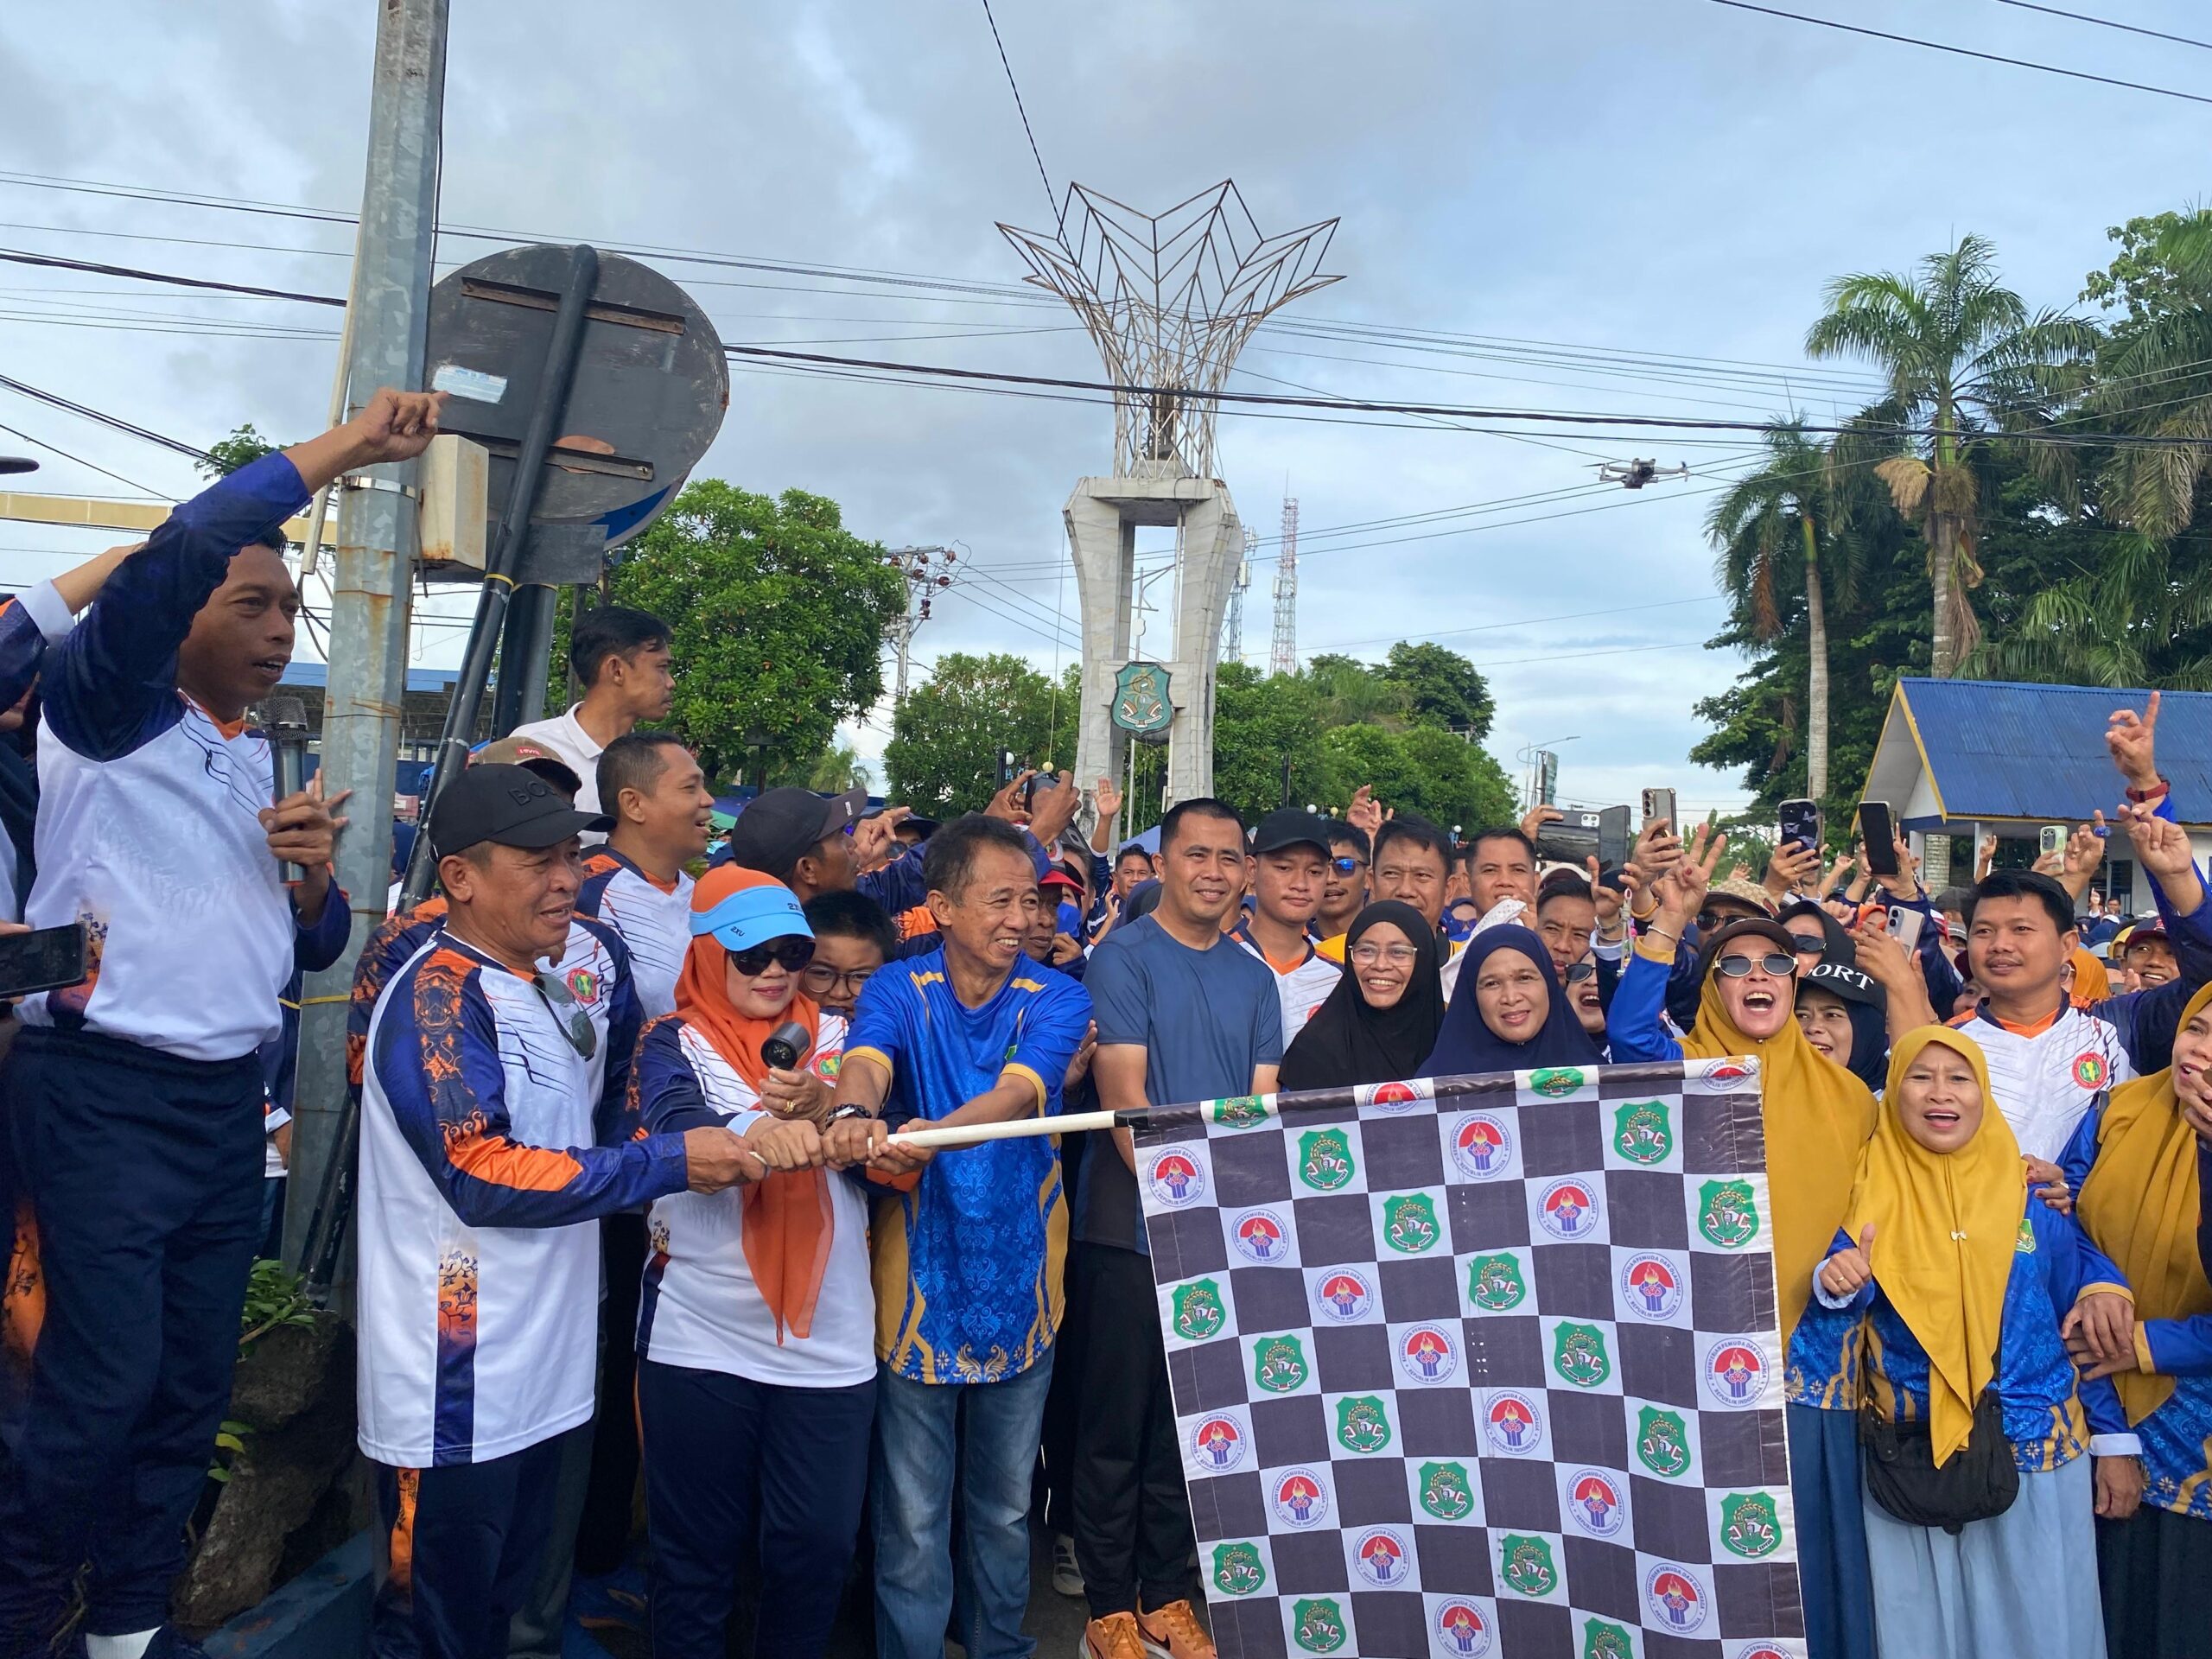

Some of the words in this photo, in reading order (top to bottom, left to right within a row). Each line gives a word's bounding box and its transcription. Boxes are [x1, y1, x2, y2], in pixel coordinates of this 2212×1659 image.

[730, 925, 746, 937] 2XU
[1805, 963, 1874, 990] ORT
[1464, 1116, 1487, 1125] PEMUDA
[1552, 1180, 1575, 1190] PEMUDA
[1720, 1340, 1745, 1349] PEMUDA
